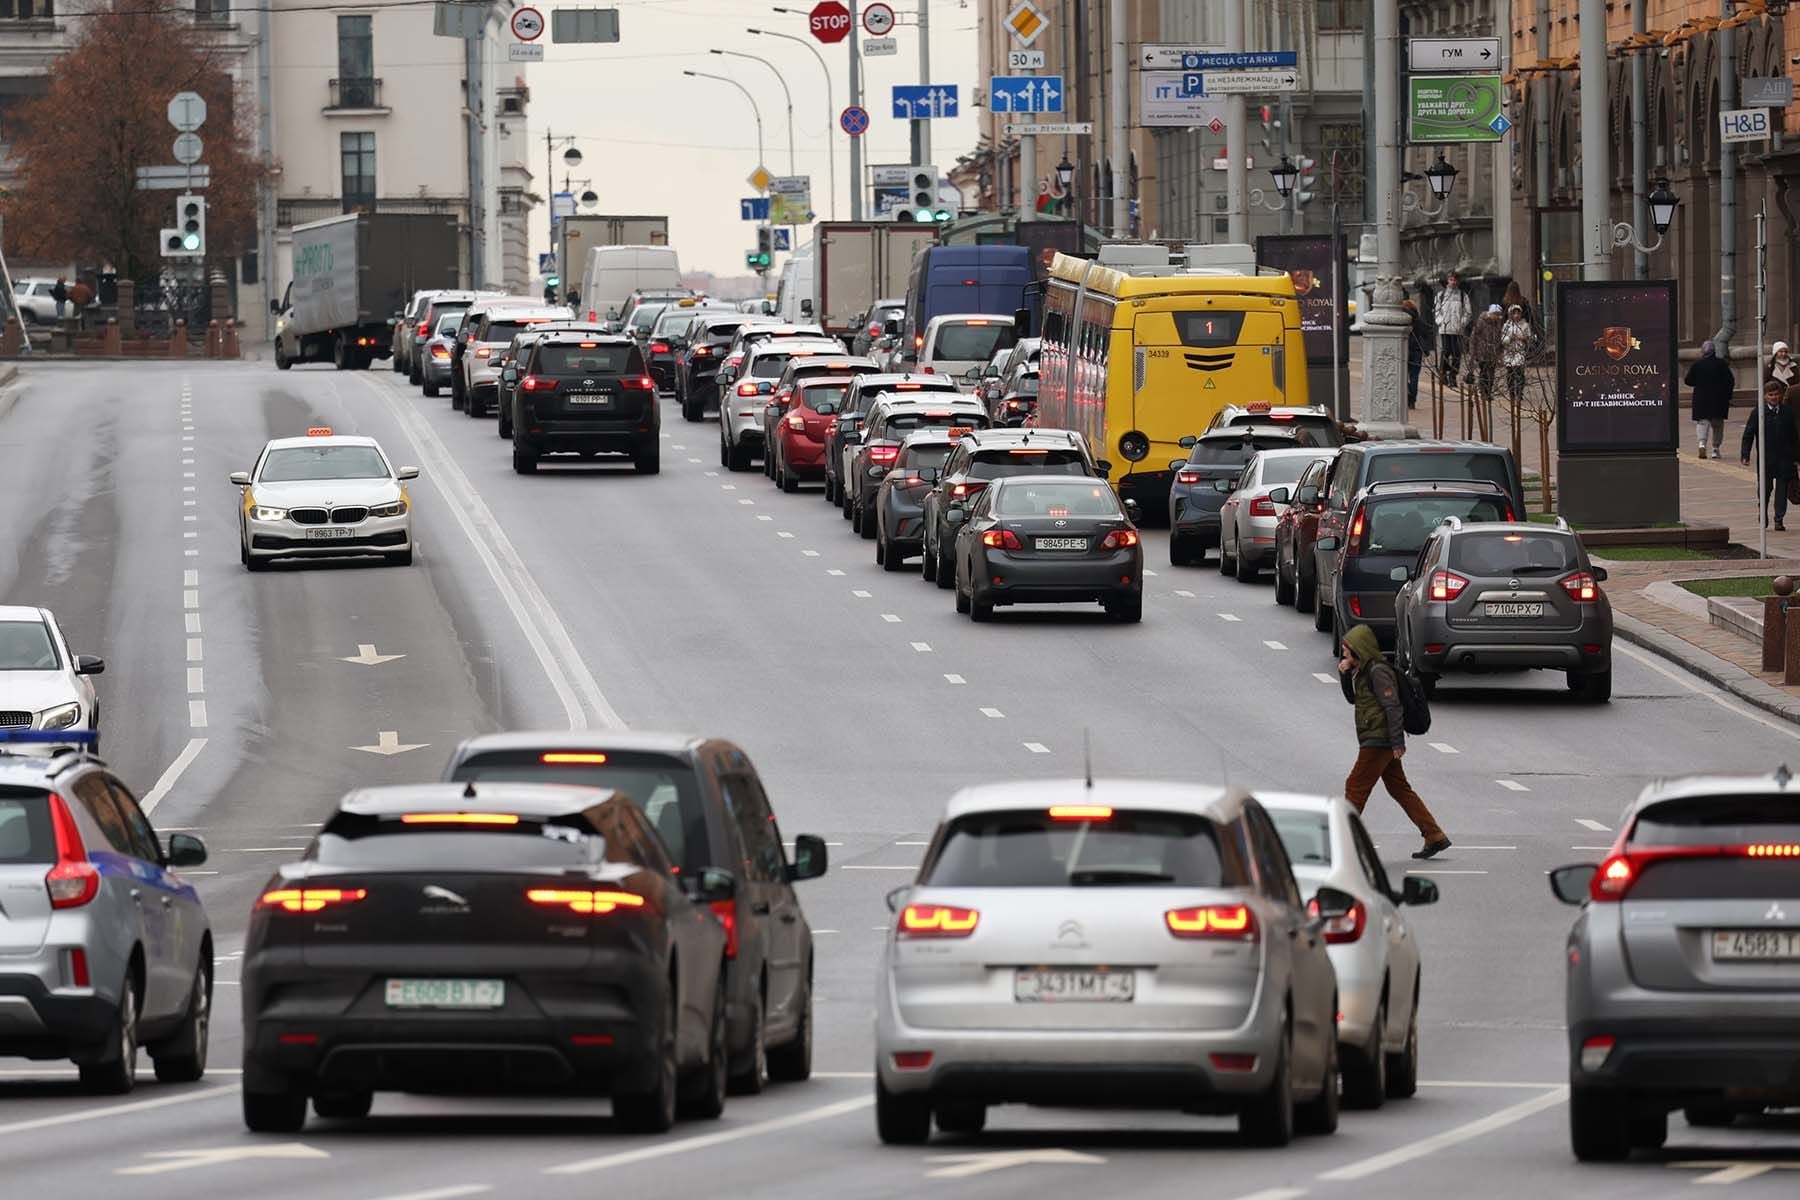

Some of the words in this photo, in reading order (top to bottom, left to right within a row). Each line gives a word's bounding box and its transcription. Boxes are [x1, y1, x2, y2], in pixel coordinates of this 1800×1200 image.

[812, 14, 849, 30] STOP
[1441, 48, 1463, 58] ГУМ
[1012, 54, 1028, 66] 30
[1202, 57, 1235, 66] МЕСЦА
[1236, 55, 1278, 65] СТАЯНКІ
[1188, 76, 1200, 92] P
[1418, 101, 1449, 109] УВАЖАЙТЕ
[1450, 101, 1466, 109] ДРУГ
[1447, 108, 1475, 116] ДОРОГАХ
[1724, 112, 1767, 134] H&B
[1307, 298, 1334, 307] ROYAL
[1205, 320, 1214, 335] 1
[1148, 349, 1170, 358] 34339
[1575, 365, 1620, 376] CASINO
[1623, 364, 1660, 375] ROYAL
[1607, 392, 1636, 400] МИНСК
[314, 529, 333, 538] 8963
[334, 528, 353, 537] TP-7
